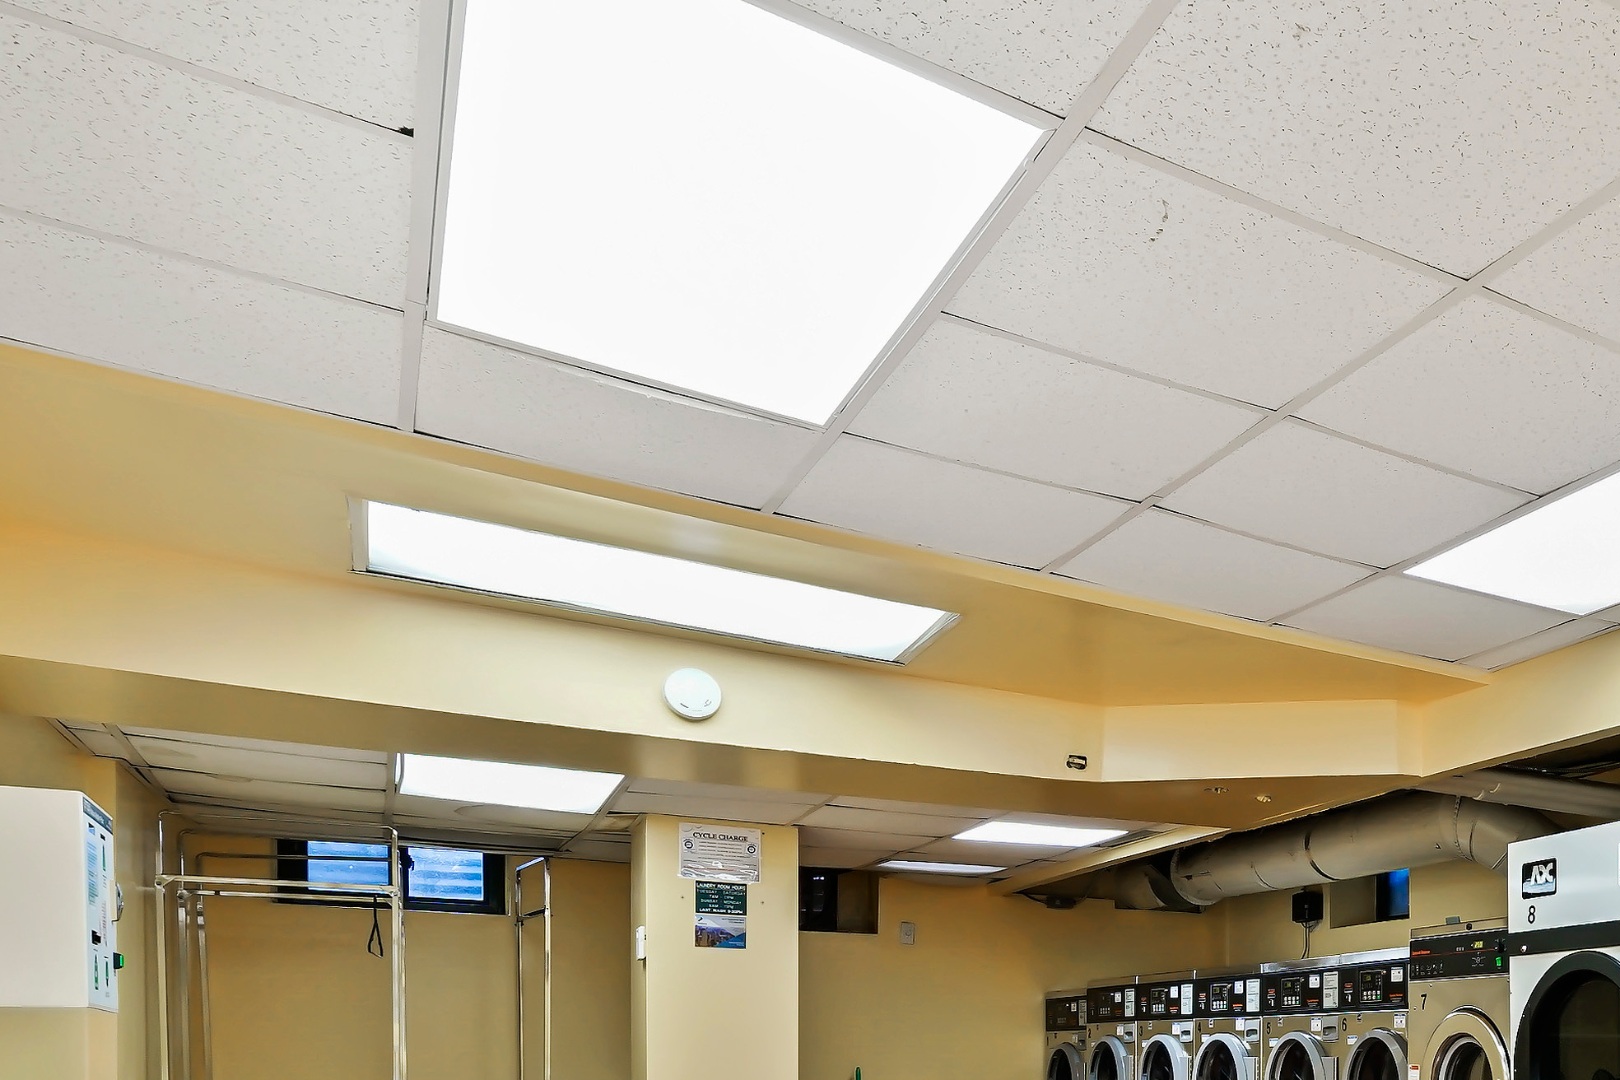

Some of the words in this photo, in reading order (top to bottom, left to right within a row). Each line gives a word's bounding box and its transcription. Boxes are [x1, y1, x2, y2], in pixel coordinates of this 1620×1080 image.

[1530, 862, 1554, 886] ADC
[1527, 905, 1536, 924] 8
[1420, 993, 1428, 1010] 7
[1266, 1021, 1272, 1035] 5
[1342, 1017, 1348, 1032] 6
[1087, 1028, 1092, 1039] 2
